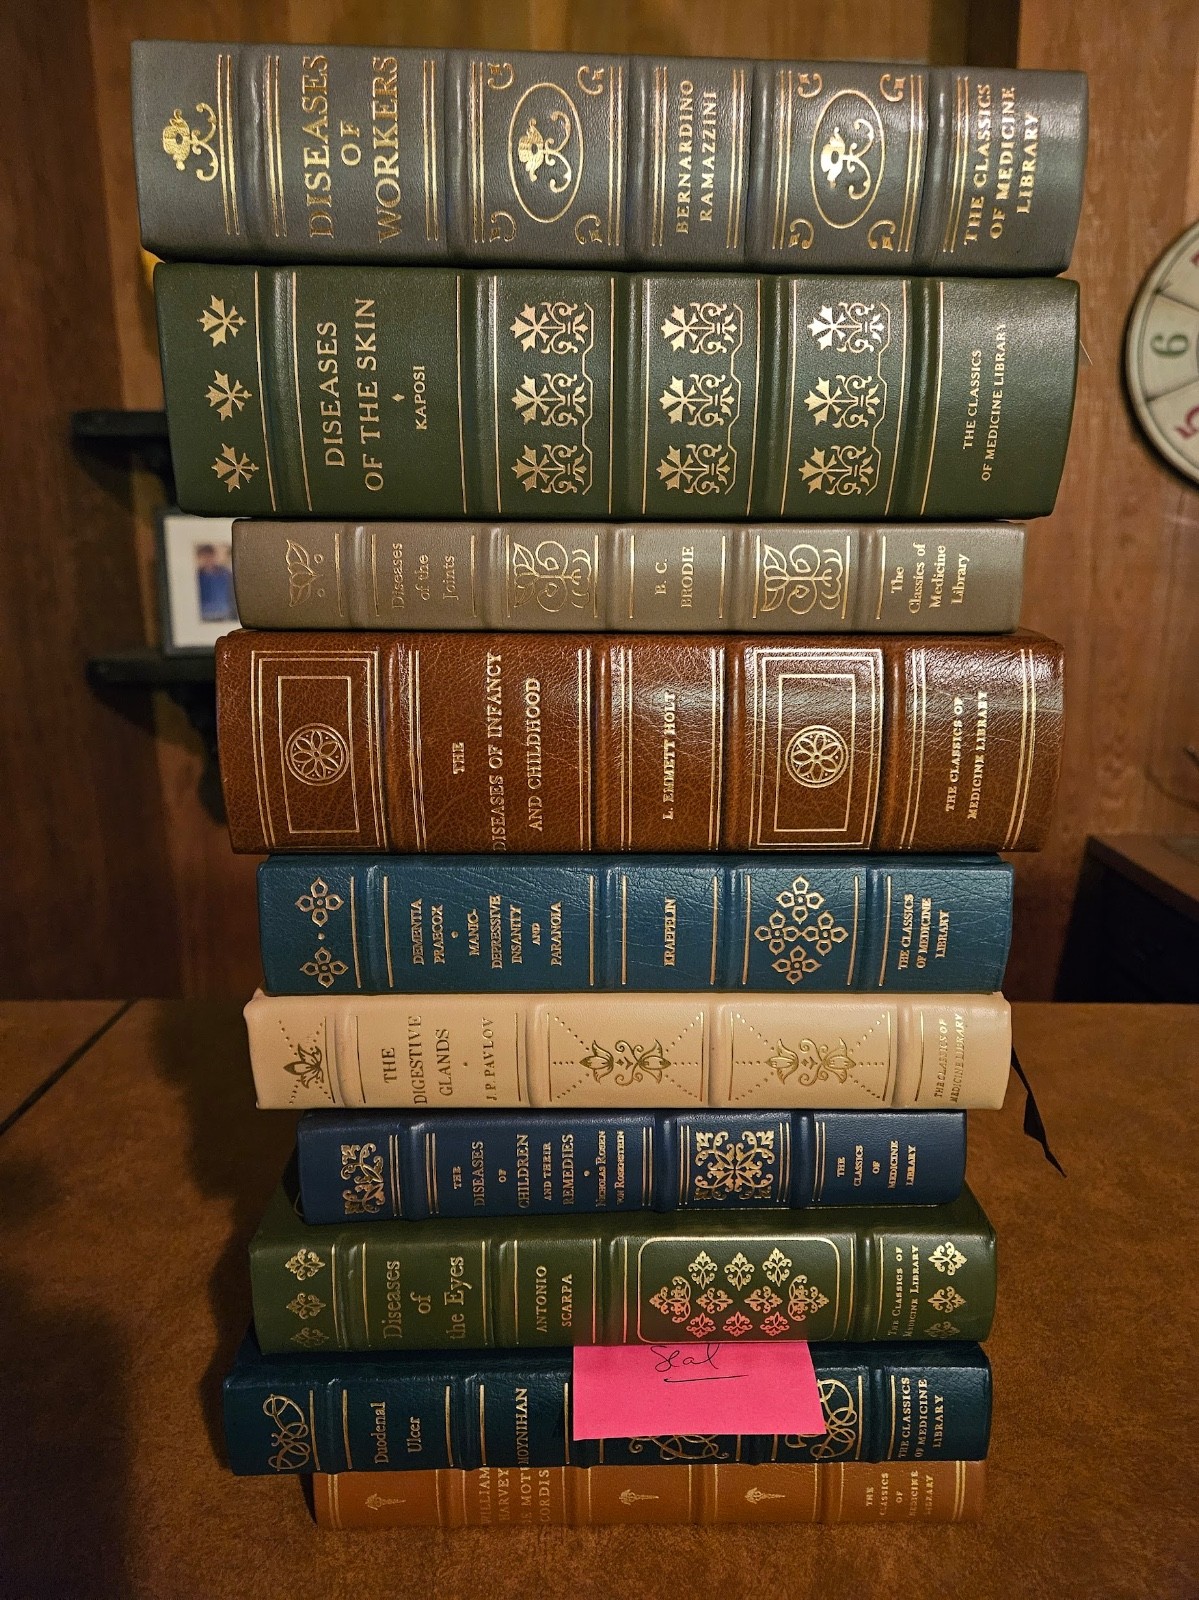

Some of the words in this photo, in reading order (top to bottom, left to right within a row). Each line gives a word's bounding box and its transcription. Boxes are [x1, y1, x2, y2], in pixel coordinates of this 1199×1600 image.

[302, 55, 334, 239] DISEASES
[341, 120, 362, 166] OF
[373, 55, 403, 243] WORKERS
[676, 79, 694, 234] BERNARDINO
[700, 91, 717, 222] RAMAZZINI
[973, 84, 991, 188] CLASSICS
[995, 87, 1015, 200] MEDICINE
[1017, 114, 1039, 213] LIBRARY
[963, 196, 984, 245] THE
[989, 208, 1006, 239] OF
[354, 298, 377, 370] SKIN
[994, 323, 1006, 386] LIBRARY
[316, 322, 345, 466] DISEASES
[413, 366, 427, 430] KAPOSI
[967, 349, 982, 416] CLASSICS
[357, 381, 380, 444] THE
[963, 420, 976, 449] THE
[985, 390, 1003, 459] MEDICINE
[362, 453, 384, 491] OF
[981, 463, 992, 481] OF
[415, 554, 429, 580] the
[655, 559, 667, 573] C.
[913, 542, 926, 556] of
[392, 543, 405, 608] Diseases
[415, 584, 430, 600] of
[443, 555, 459, 600] Joints
[655, 581, 667, 594] B.
[681, 546, 694, 607] BRODIE
[891, 567, 904, 593] The
[909, 562, 925, 613] Classics
[929, 545, 946, 608] Medicine
[951, 554, 969, 604] Library
[486, 651, 502, 738] INFANCY
[664, 692, 675, 735] HOLT
[954, 697, 963, 715] OF
[452, 741, 465, 774] THE
[488, 744, 503, 769] OF
[526, 677, 541, 790] CHILDHOOD
[950, 720, 962, 782] CLASSICS
[968, 754, 984, 819] MEDICINE
[976, 691, 988, 750] LIBRARY
[663, 739, 675, 802] EMMETT
[489, 775, 507, 851] DISEASES
[528, 795, 543, 831] AND
[663, 807, 673, 820] L.
[946, 786, 957, 811] THE
[411, 899, 424, 965] DEMENTIA
[432, 905, 445, 964] PRAECOX
[468, 909, 480, 955] MANIC-
[490, 895, 502, 968] DEPRESSIVE
[510, 905, 522, 963] INSANITY
[532, 923, 541, 945] AND
[551, 902, 562, 966] PARANOIA
[664, 897, 676, 966] KRAEPELIN
[902, 894, 914, 947] CLASSICS
[918, 898, 931, 953] MEDICINE
[935, 910, 949, 958] LIBRARY
[898, 950, 910, 969] THE
[916, 955, 926, 968] OF
[939, 1019, 948, 1034] OF
[955, 1014, 965, 1060] LIBRARY
[381, 1048, 397, 1083] THE
[408, 1016, 427, 1104] DIGESTIVE
[435, 1029, 453, 1096] GLANDS
[937, 1034, 948, 1082] CLASSICS
[950, 1061, 964, 1103] MEDICINE
[934, 1082, 945, 1097] THE
[453, 1166, 462, 1189] THE
[472, 1141, 485, 1206] DISEASES
[498, 1169, 507, 1183] OF
[517, 1134, 530, 1208] CHILDREN
[543, 1142, 551, 1179] THEIR
[562, 1134, 574, 1204] REMEDIES
[837, 1157, 845, 1177] THE
[854, 1145, 863, 1186] CLASSICS
[872, 1161, 880, 1174] OF
[888, 1141, 898, 1188] MEDICINE
[906, 1145, 916, 1185] LIBRARY
[543, 1181, 552, 1200] AND
[382, 1261, 402, 1338] Diseases
[410, 1291, 431, 1314] of
[444, 1256, 473, 1305] Eyes
[536, 1266, 547, 1332] ANTONIO
[561, 1274, 572, 1327] SCARPA
[446, 1314, 465, 1339] the
[515, 1388, 529, 1464] MOYNIHAN
[901, 1377, 911, 1438] CLASSICS
[918, 1379, 928, 1444] MEDICINE
[933, 1394, 944, 1447] LIBRARY
[370, 1402, 389, 1463] Duodenal
[406, 1417, 423, 1452] Ulcer
[898, 1440, 909, 1458] THE
[915, 1448, 924, 1458] OF
[479, 1467, 492, 1524] WILLIAM
[498, 1468, 510, 1521] HARVEY
[521, 1512, 532, 1523] E
[539, 1470, 550, 1522] CORDIS
[866, 1486, 874, 1506] THE
[896, 1490, 903, 1503] OF
